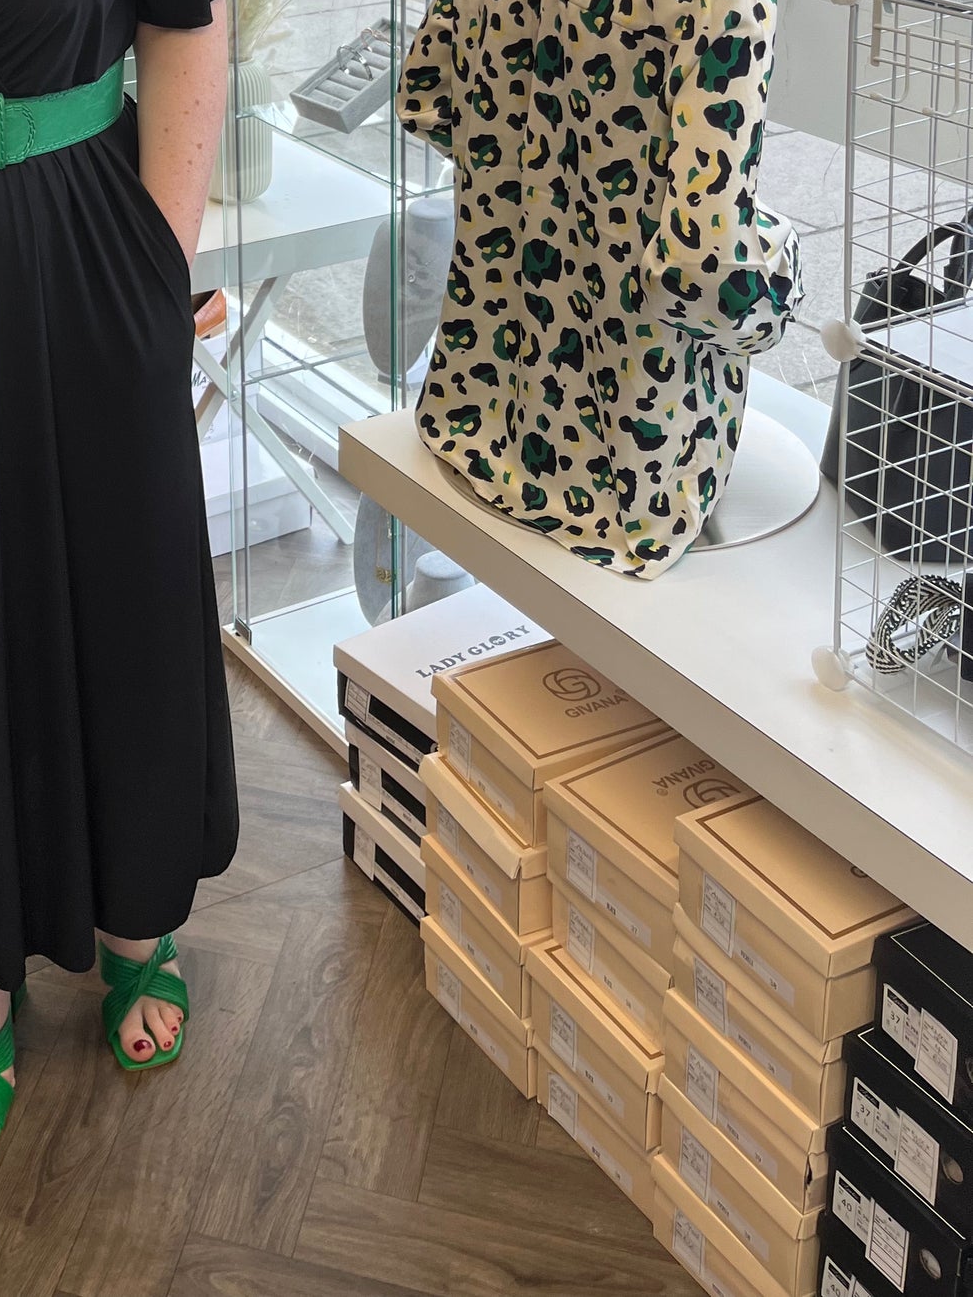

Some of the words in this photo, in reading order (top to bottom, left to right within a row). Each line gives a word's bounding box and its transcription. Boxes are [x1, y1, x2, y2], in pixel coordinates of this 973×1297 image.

[416, 652, 467, 679] LADY
[468, 624, 530, 656] GLORY
[565, 693, 629, 718] GIVANA
[651, 759, 716, 790] GIVANA
[890, 1010, 900, 1024] 37
[859, 1103, 871, 1117] 37
[841, 1199, 852, 1212] 40
[830, 1284, 841, 1297] 40
